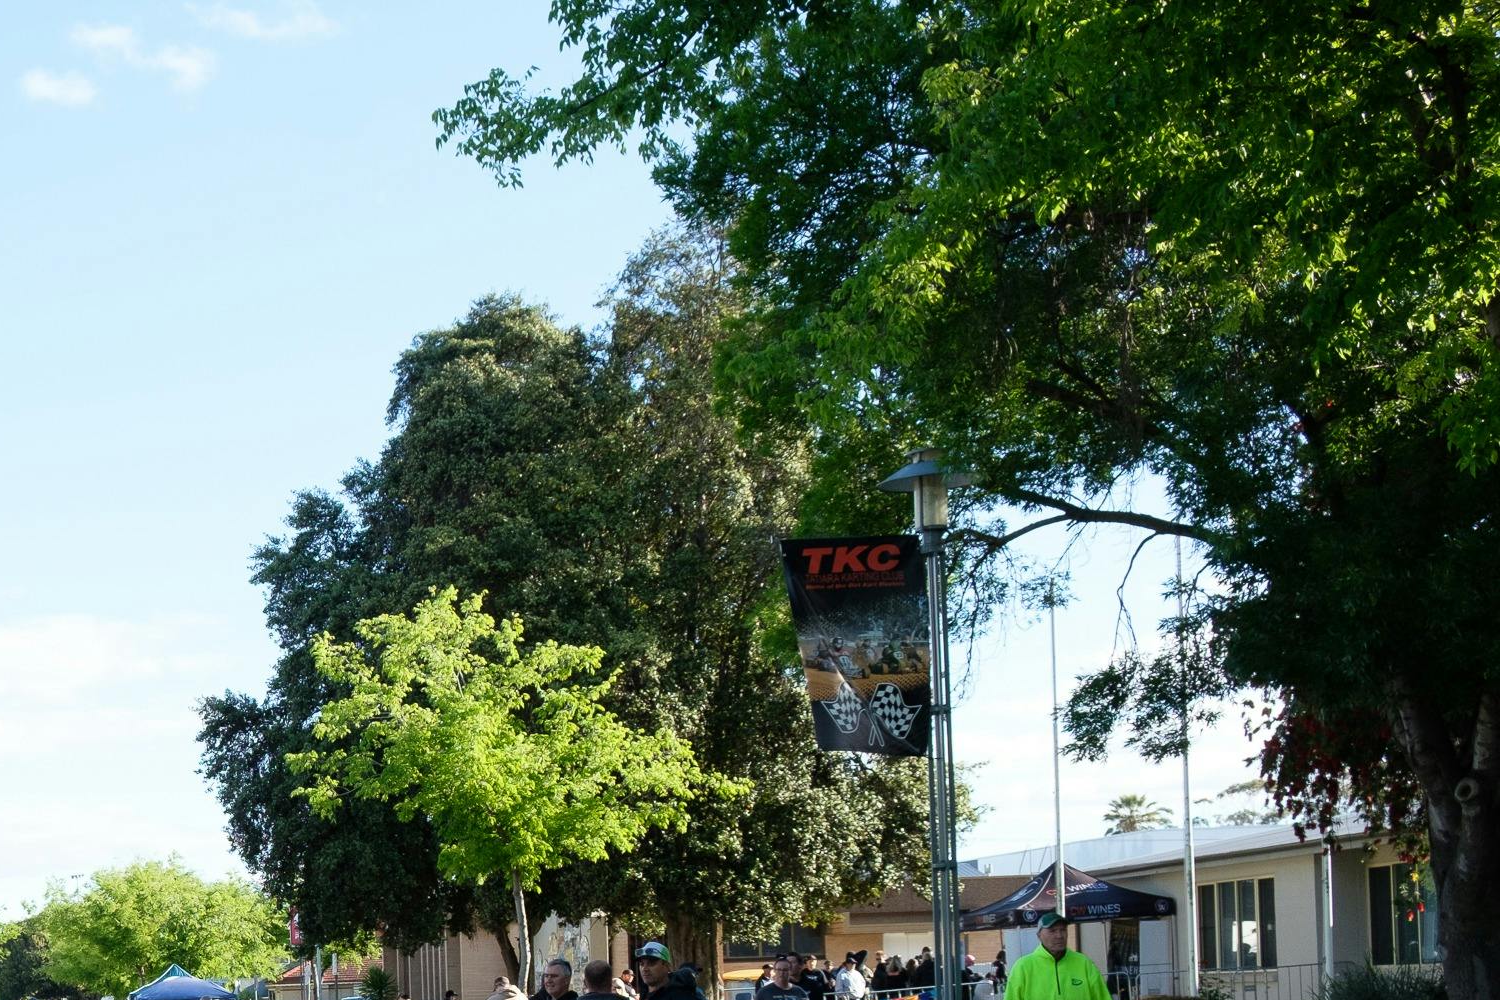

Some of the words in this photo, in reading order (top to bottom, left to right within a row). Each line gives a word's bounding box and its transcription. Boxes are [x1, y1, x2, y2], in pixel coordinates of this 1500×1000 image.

[802, 543, 901, 574] TKC
[1066, 881, 1109, 893] WINES
[1087, 903, 1121, 915] WINES
